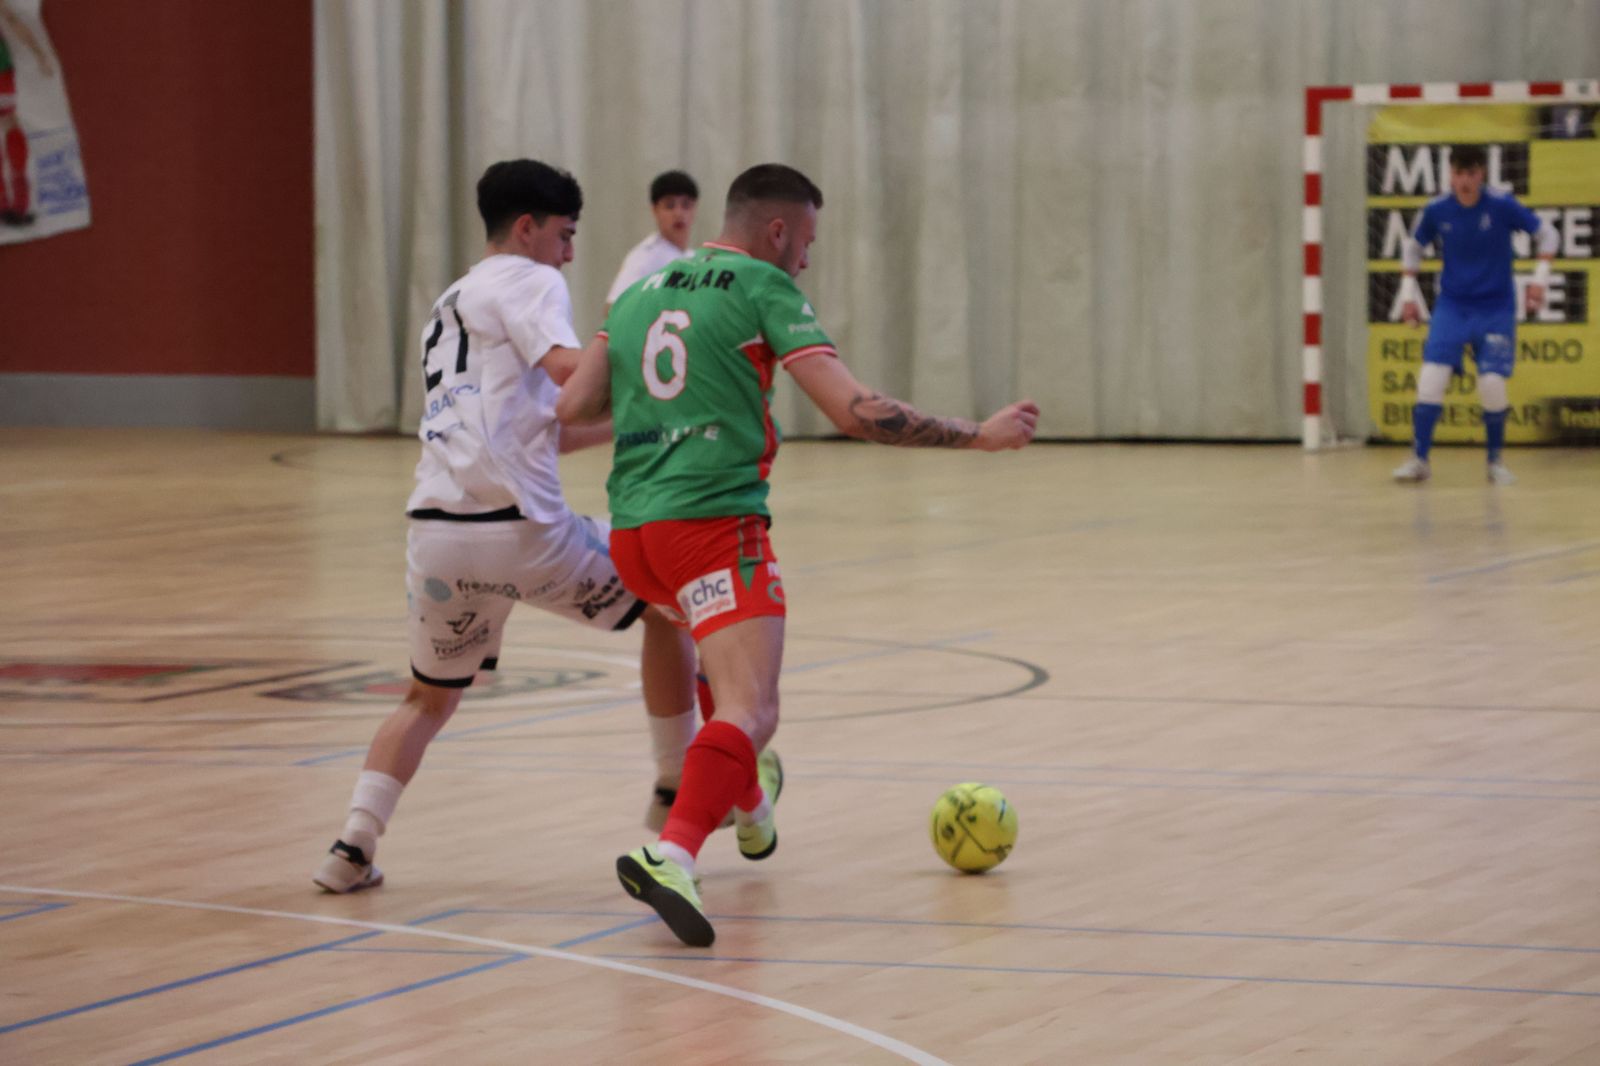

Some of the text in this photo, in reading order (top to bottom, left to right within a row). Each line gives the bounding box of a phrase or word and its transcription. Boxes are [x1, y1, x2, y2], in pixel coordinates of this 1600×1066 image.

[1382, 146, 1514, 194] MIL
[642, 309, 691, 401] 6
[691, 578, 729, 606] chc
